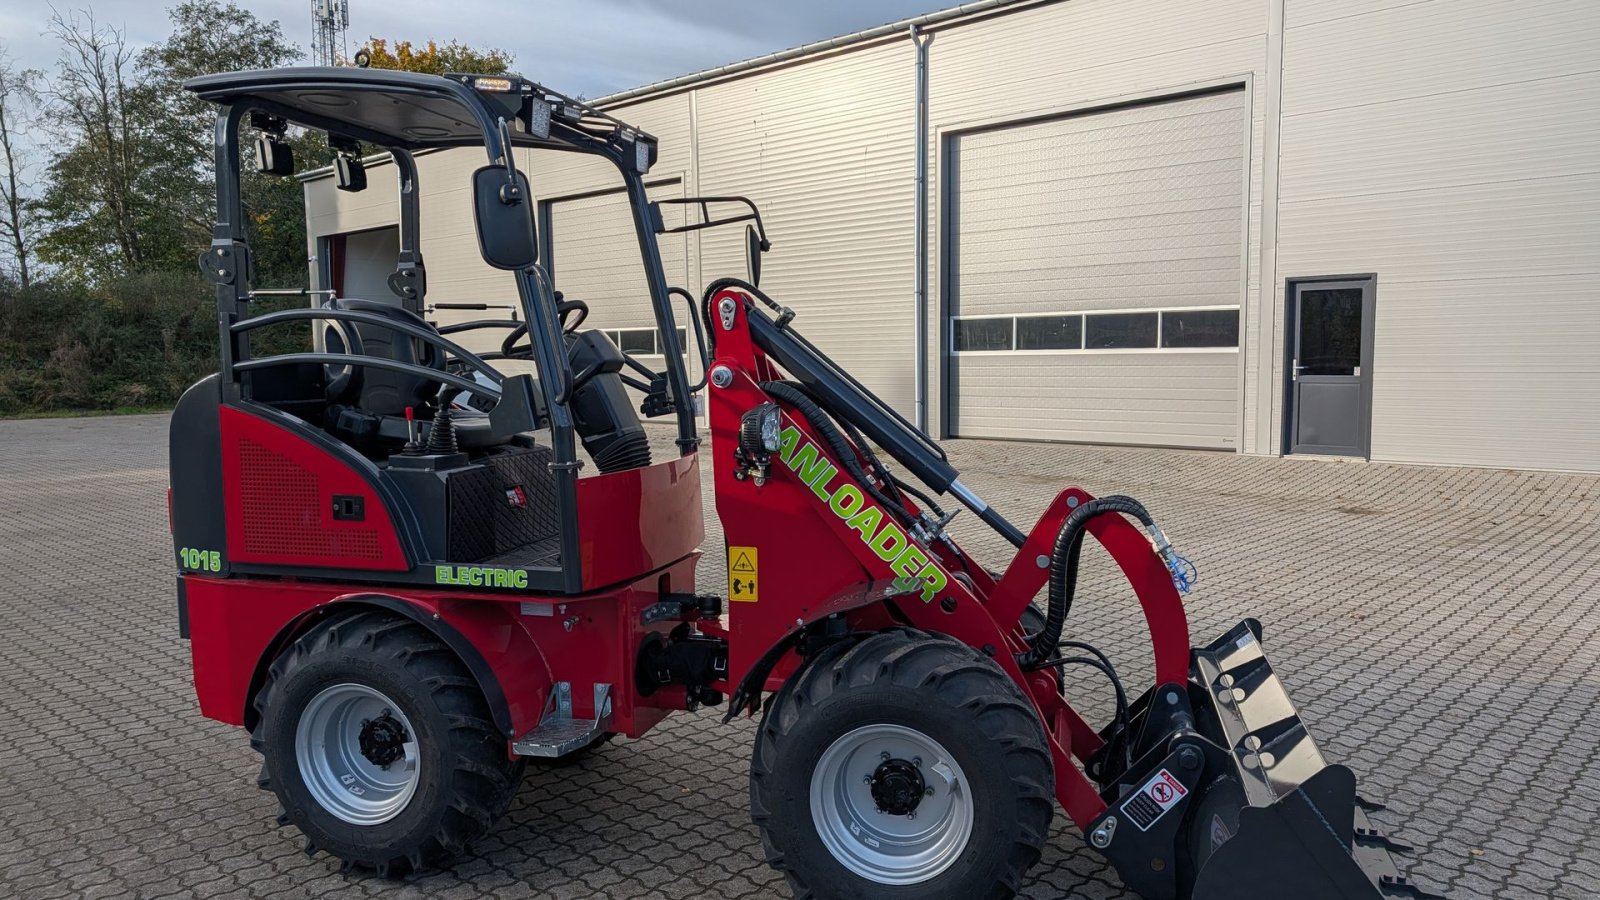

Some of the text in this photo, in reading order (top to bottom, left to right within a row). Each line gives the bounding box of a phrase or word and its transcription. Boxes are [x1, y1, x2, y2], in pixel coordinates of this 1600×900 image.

[779, 417, 948, 603] ANLOADER
[180, 547, 221, 572] 1015
[435, 565, 528, 588] ELECTRIC
